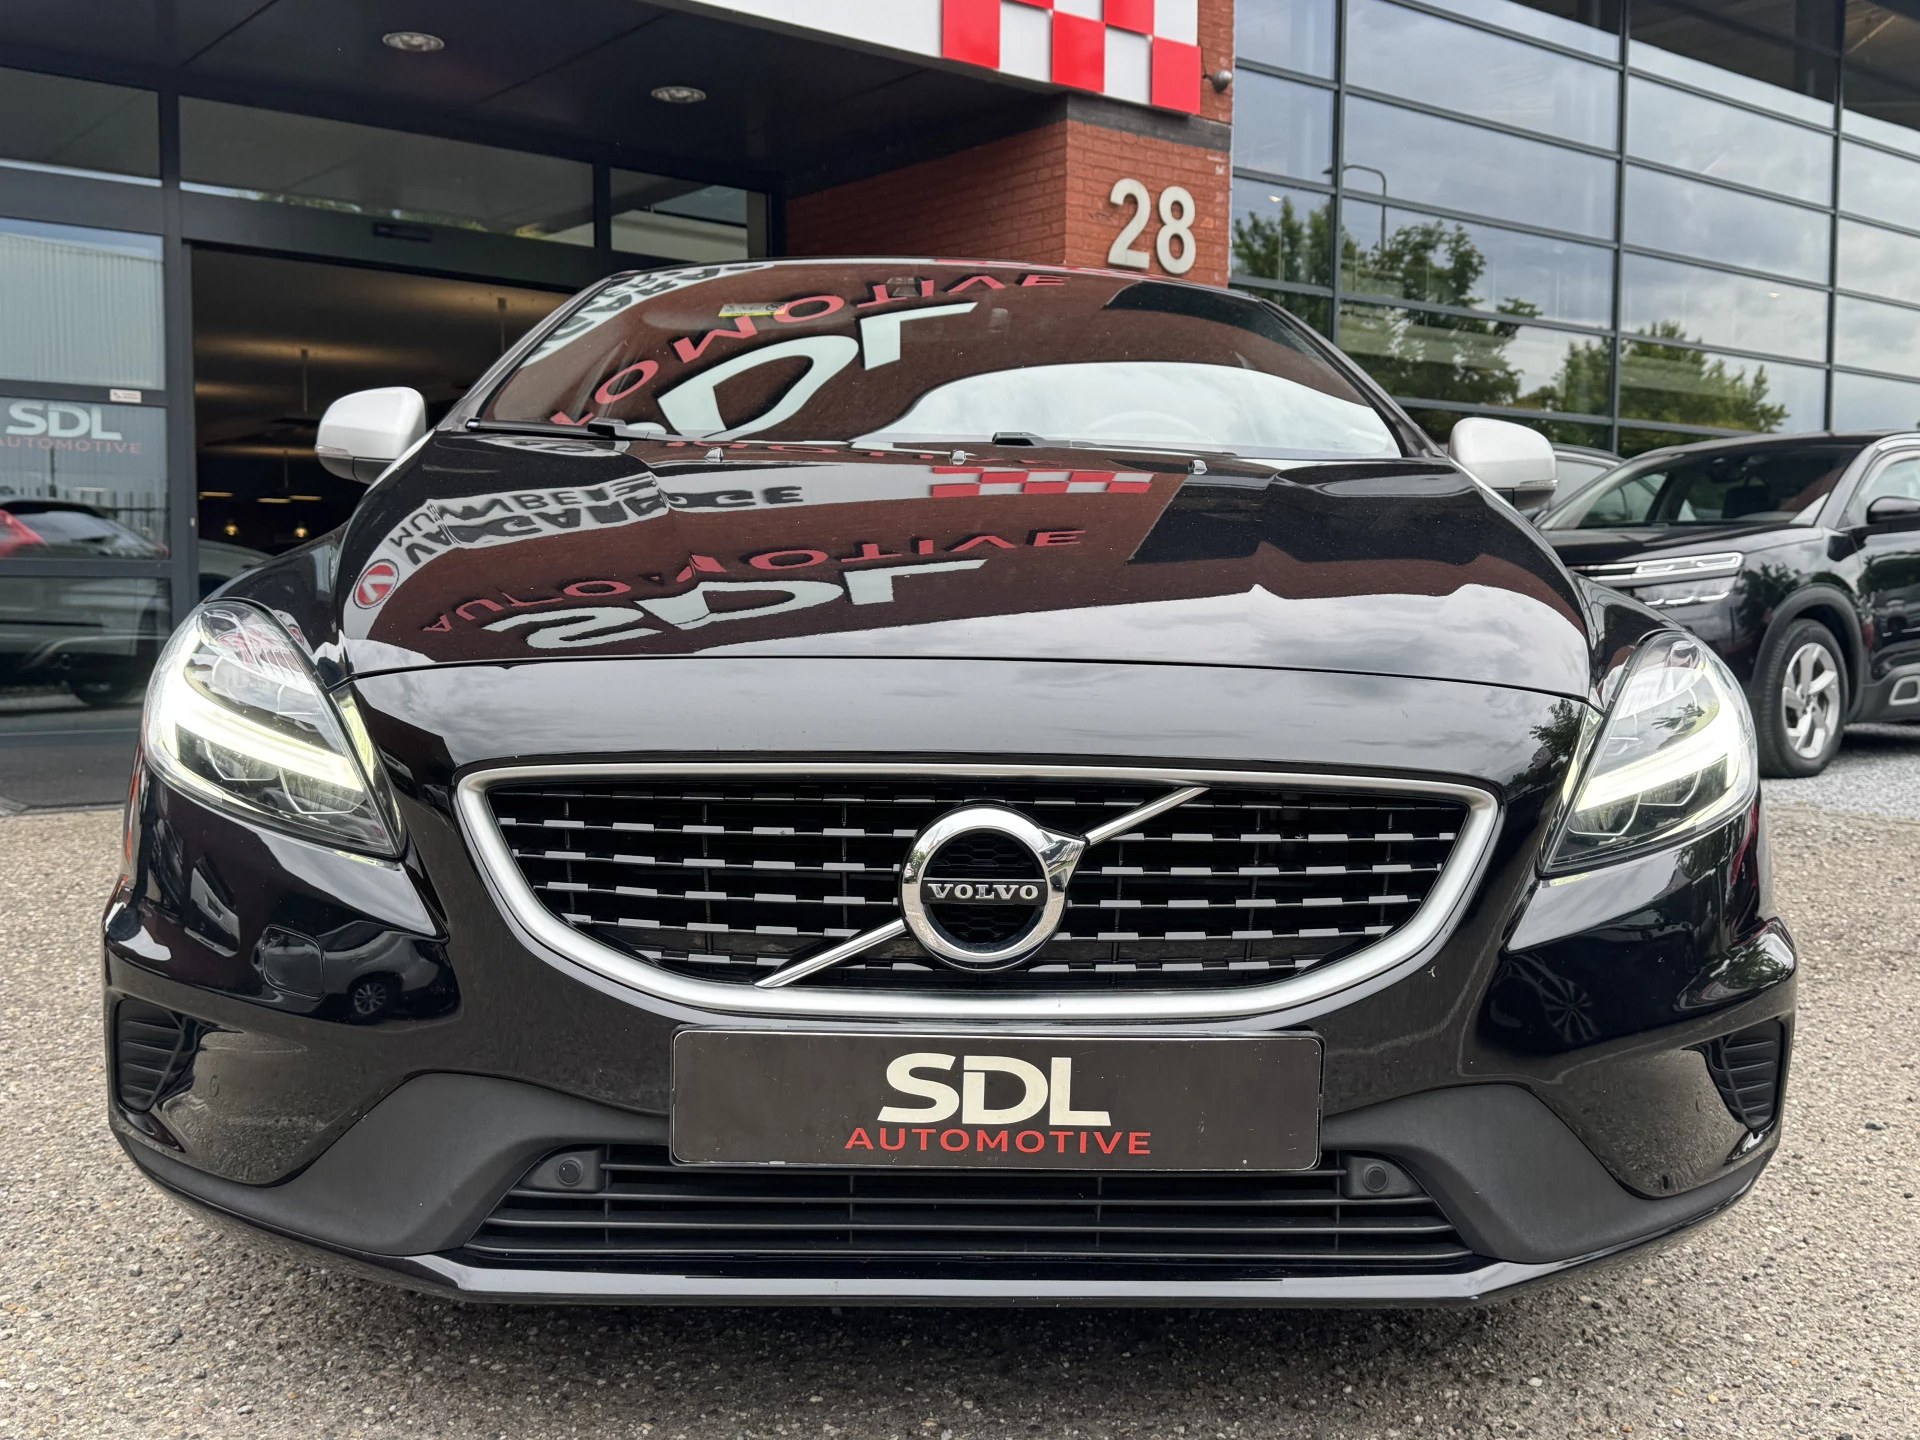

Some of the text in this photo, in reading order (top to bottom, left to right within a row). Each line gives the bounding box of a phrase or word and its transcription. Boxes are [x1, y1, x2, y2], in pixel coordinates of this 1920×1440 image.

[1108, 178, 1197, 275] 28
[5, 400, 123, 441] SDL
[927, 883, 1039, 900] VOLVO
[877, 1052, 1112, 1127] SDL
[844, 1127, 1151, 1155] AUTOMOTIVE
